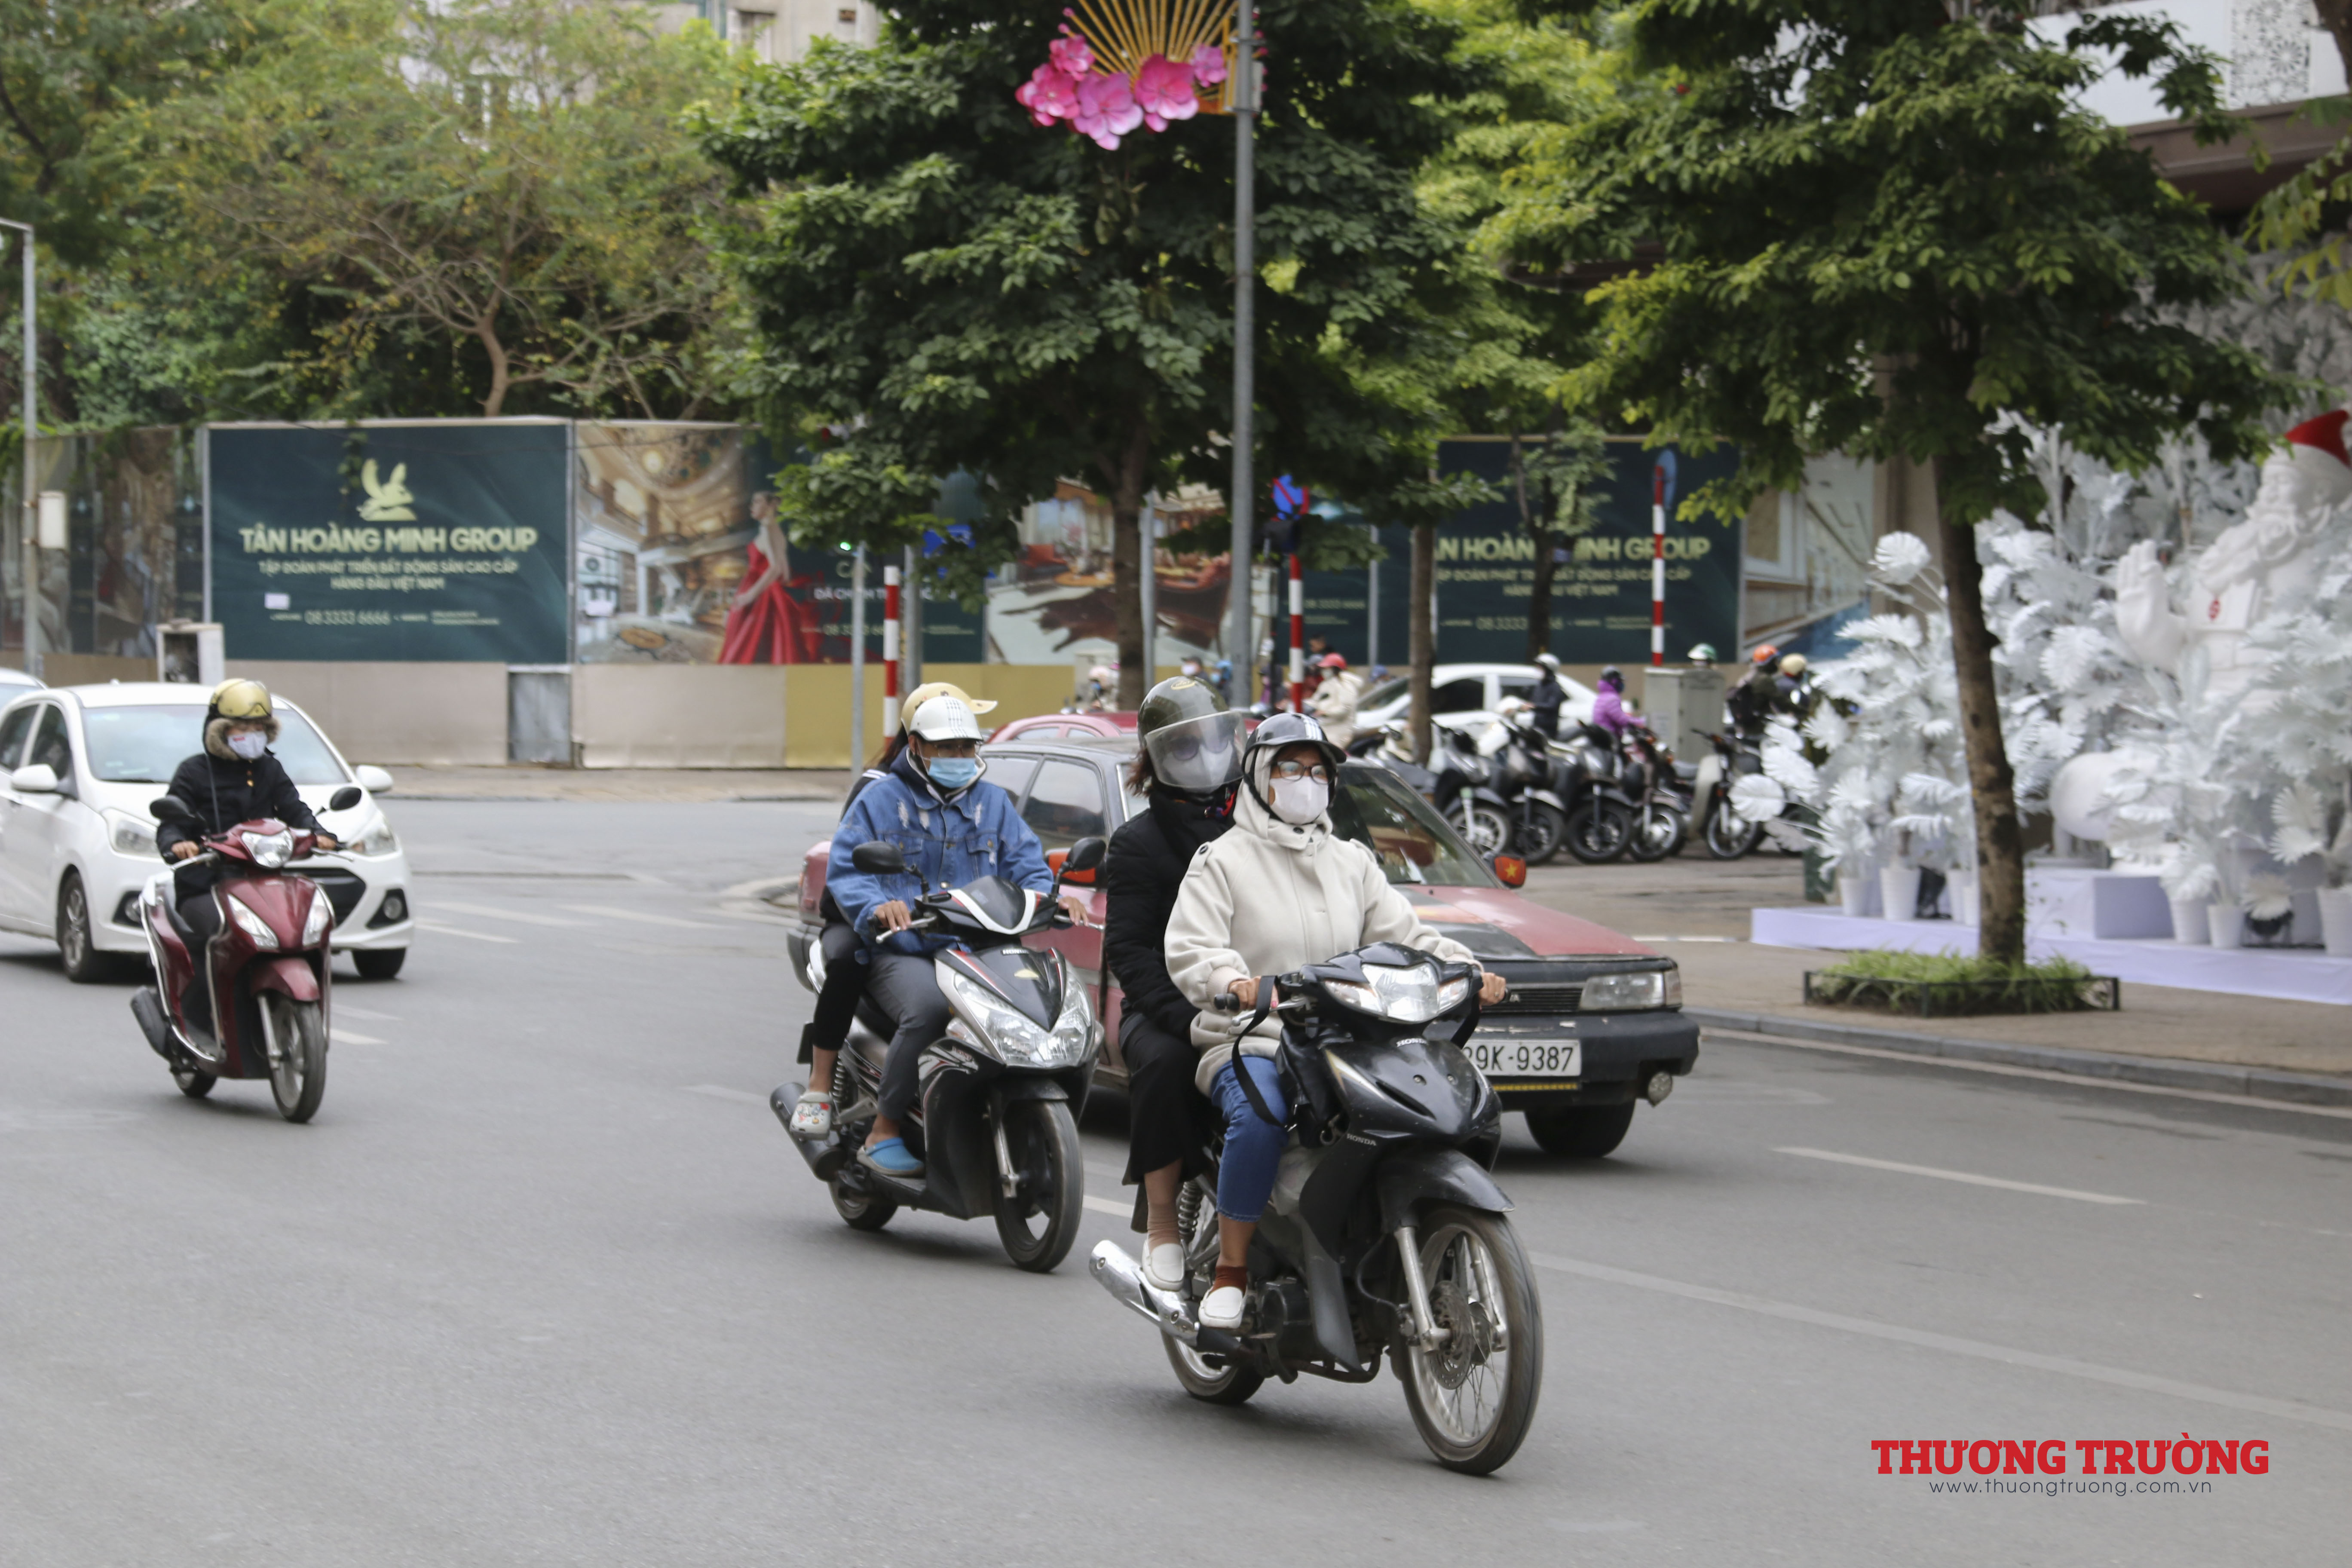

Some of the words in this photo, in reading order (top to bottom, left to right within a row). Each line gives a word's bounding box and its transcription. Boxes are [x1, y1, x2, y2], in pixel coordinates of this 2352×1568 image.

[239, 522, 287, 553] TÂN
[290, 521, 382, 553] HOÀNG
[385, 527, 447, 553] MINH
[450, 527, 538, 552] GROUP
[1463, 531, 1535, 560] HOÀN
[1396, 1038, 1428, 1047] HONDA
[1347, 1133, 1377, 1146] HONDA
